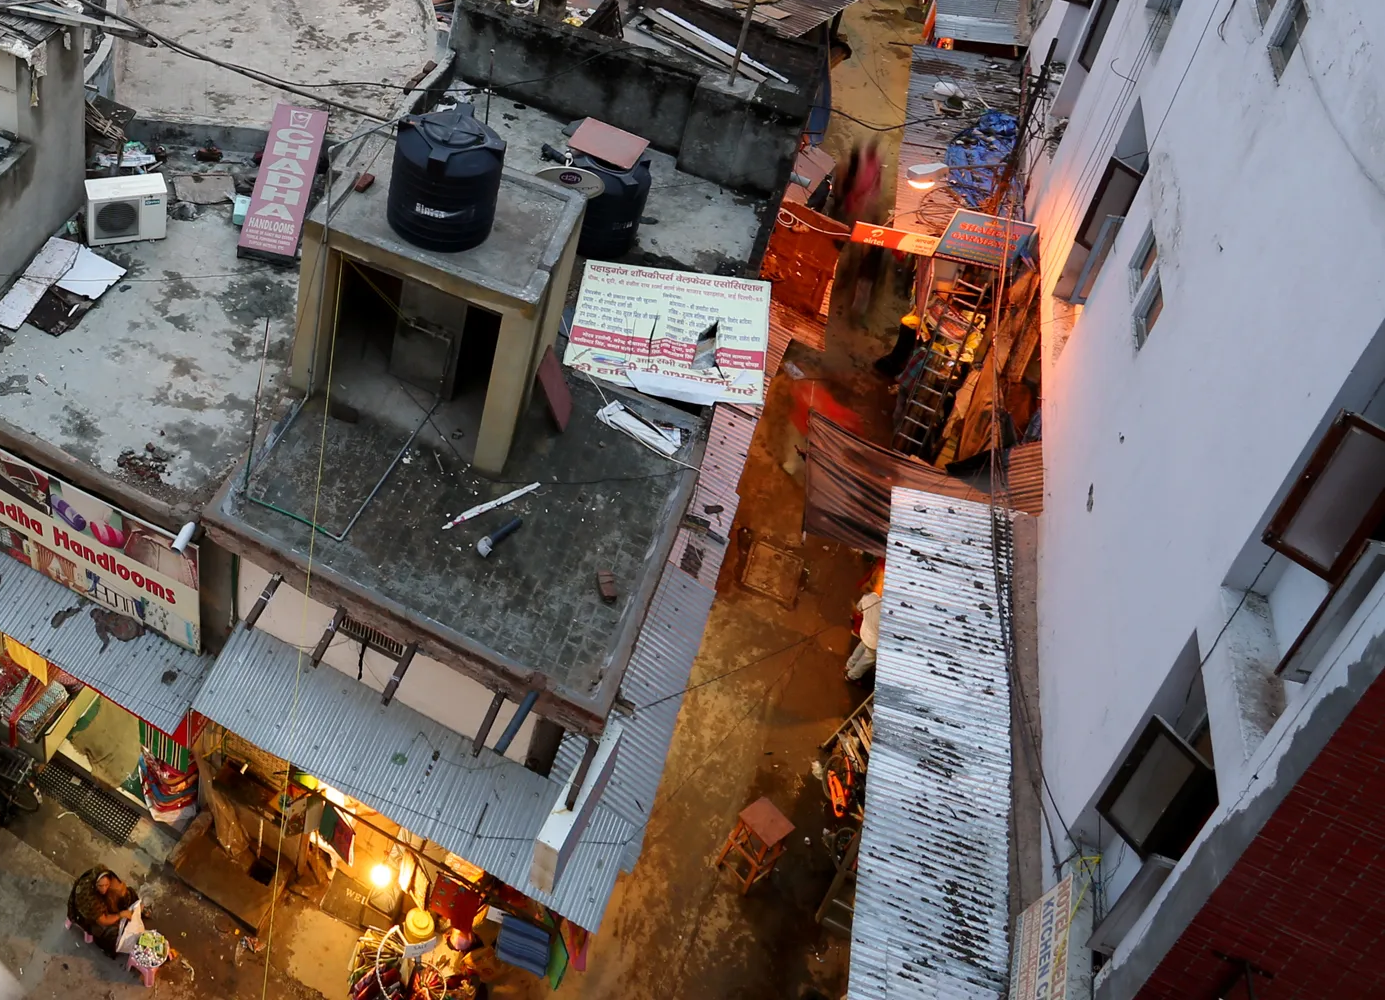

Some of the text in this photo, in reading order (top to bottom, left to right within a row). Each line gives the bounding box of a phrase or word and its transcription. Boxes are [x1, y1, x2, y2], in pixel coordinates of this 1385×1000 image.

[254, 127, 315, 222] CHADHA
[248, 216, 295, 235] HANDLOOMS
[862, 237, 885, 247] airtel
[712, 278, 764, 293] एसोसिएशन
[52, 525, 177, 605] Handlooms
[1037, 896, 1055, 980] KITCHEN
[1054, 875, 1072, 942] HOTEL
